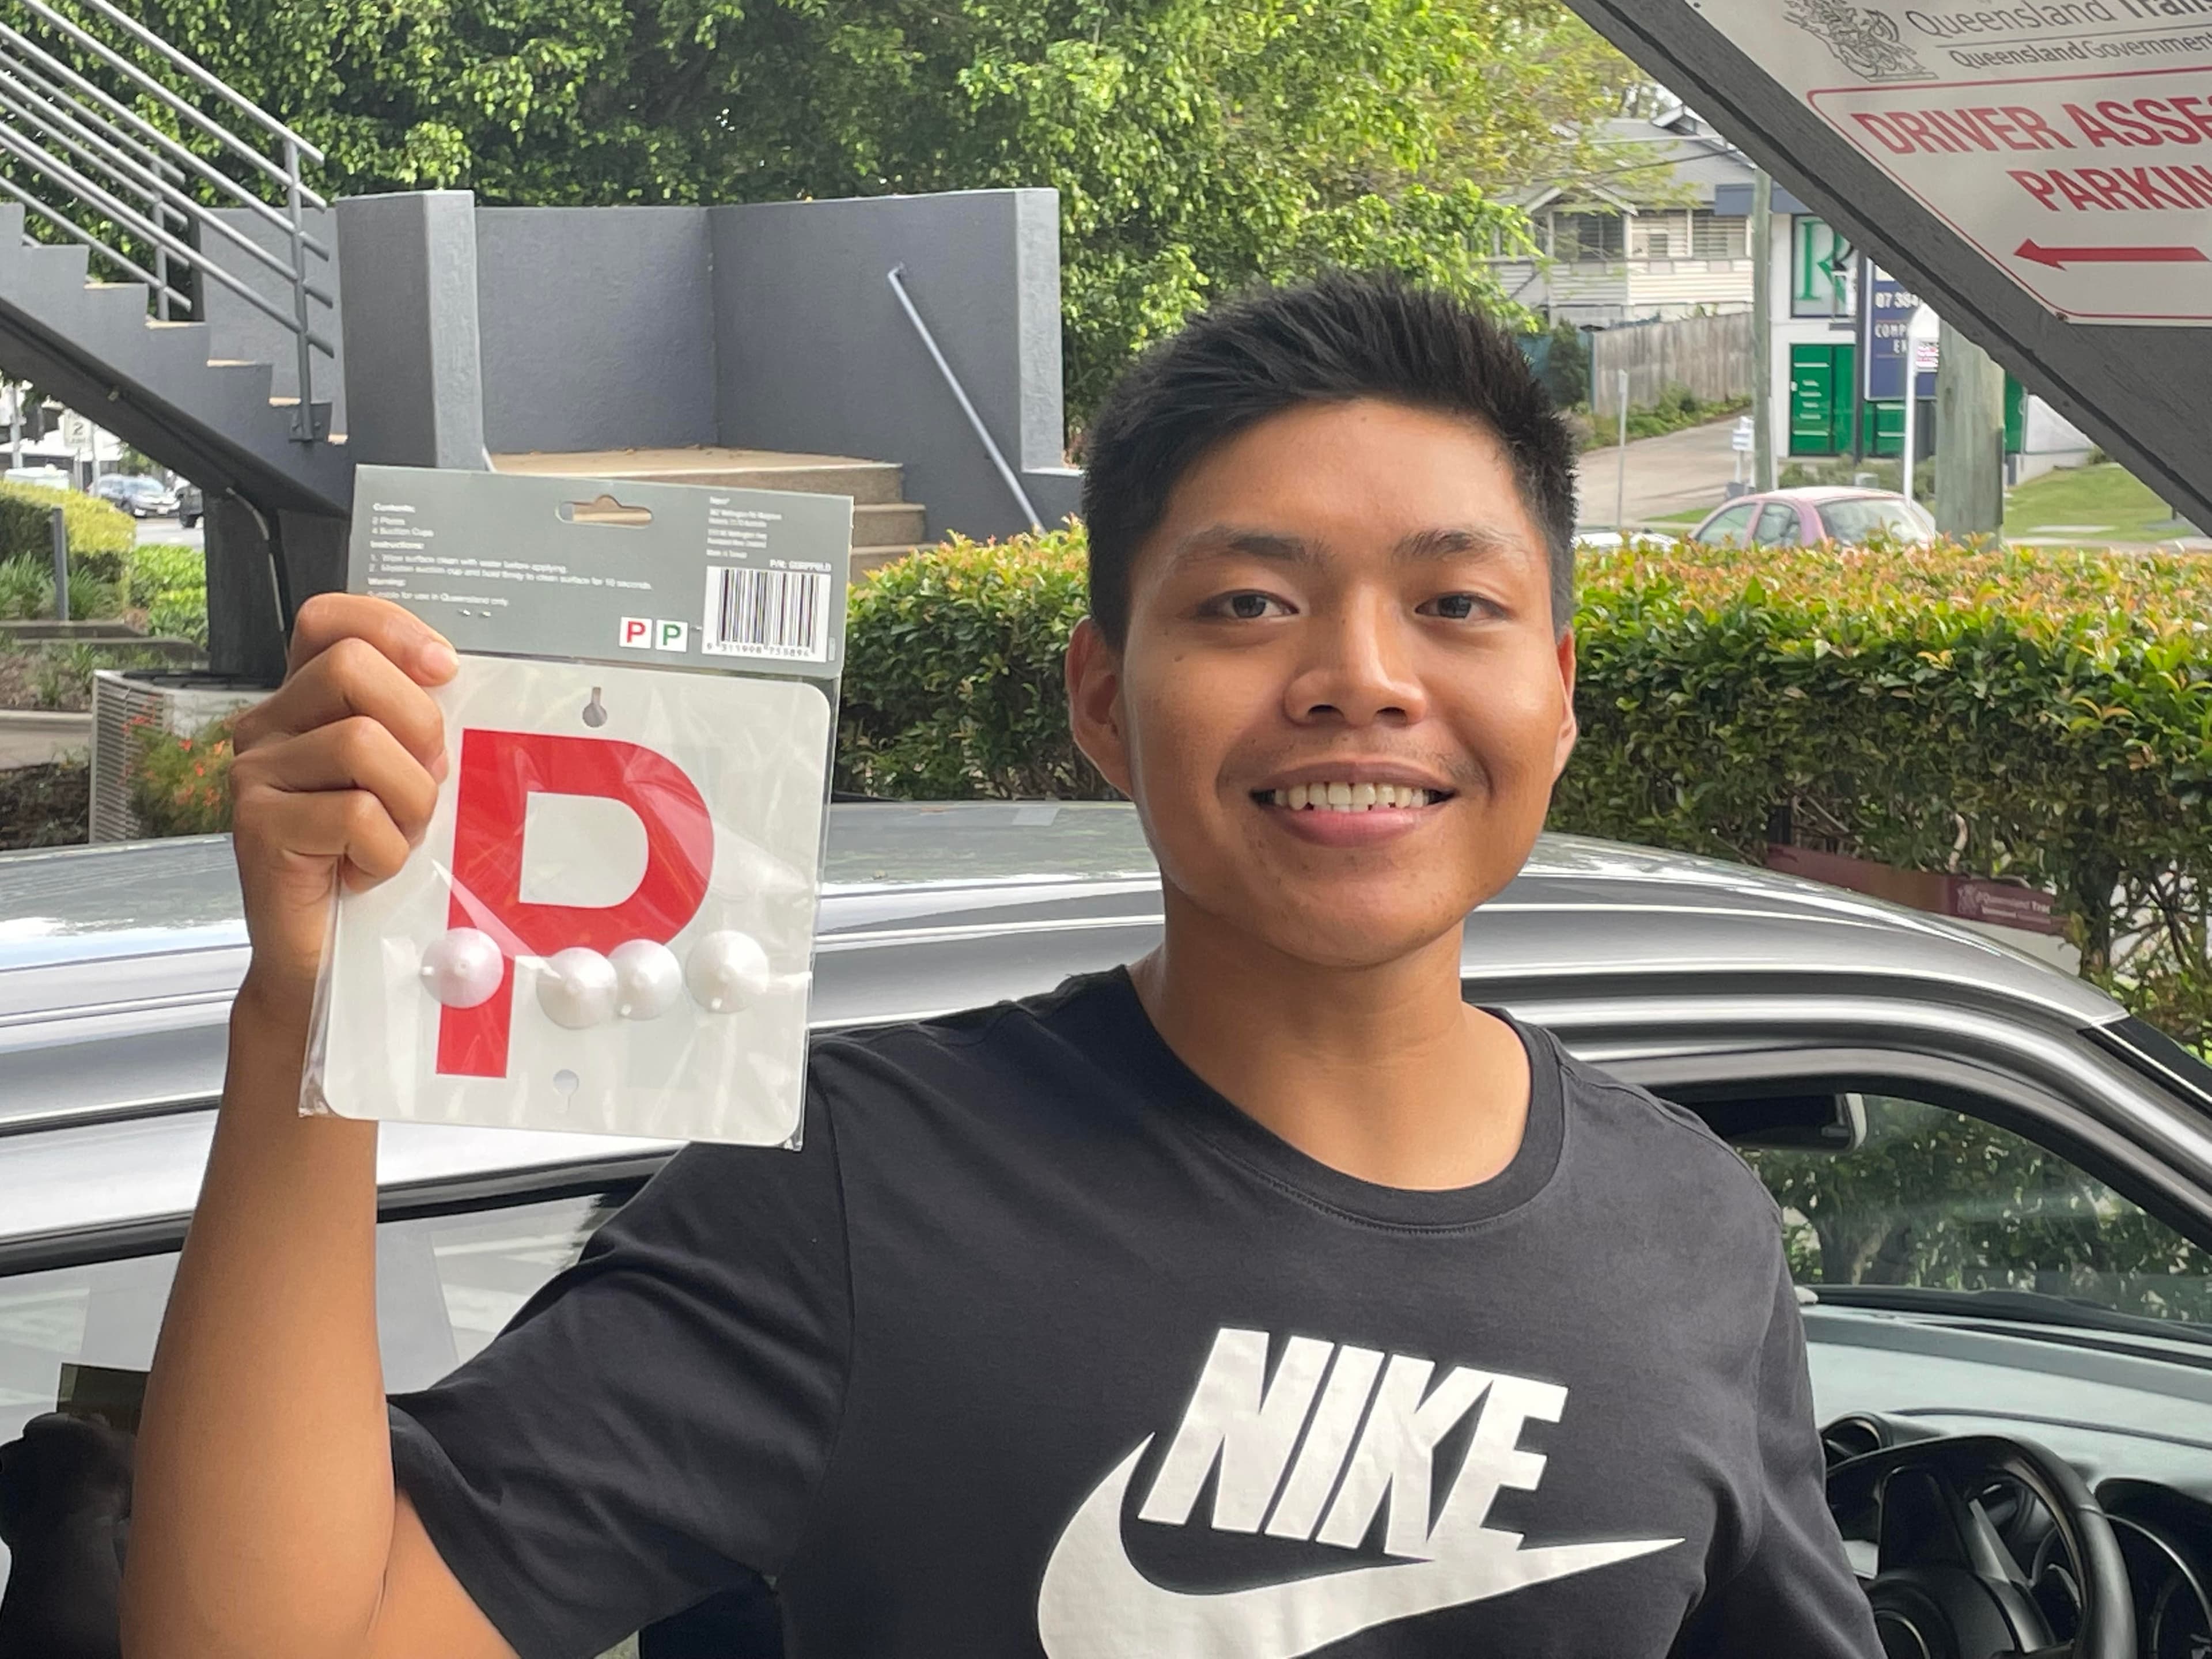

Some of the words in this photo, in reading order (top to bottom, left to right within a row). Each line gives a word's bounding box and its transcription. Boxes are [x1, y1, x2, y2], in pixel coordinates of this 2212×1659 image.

[1906, 0, 2118, 38] Queensland
[1850, 106, 2077, 154] DRIVER
[2061, 95, 2212, 147] ASSE
[626, 621, 646, 643] P
[662, 623, 681, 646] P
[436, 728, 715, 1078] P
[1138, 1327, 1569, 1562] NIKE
